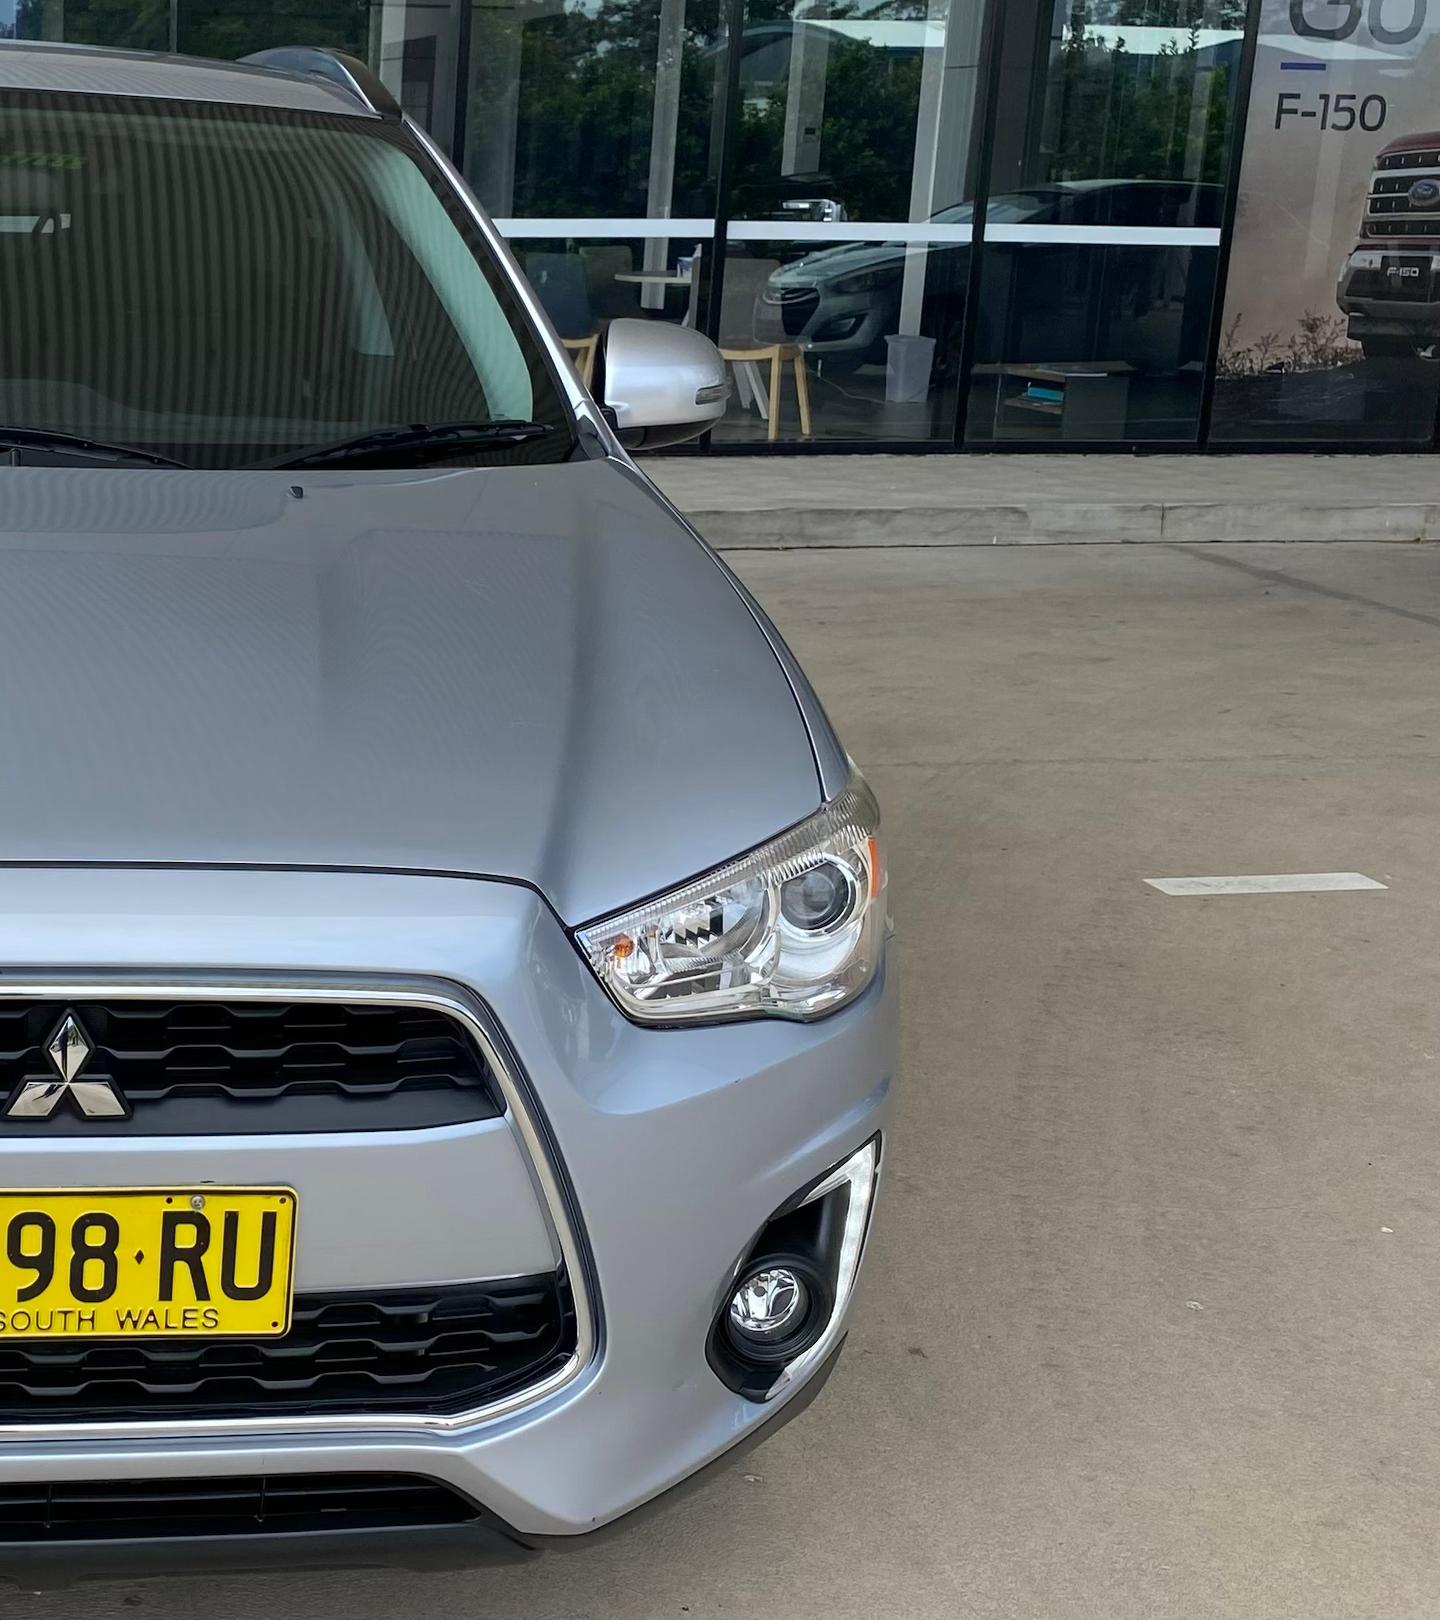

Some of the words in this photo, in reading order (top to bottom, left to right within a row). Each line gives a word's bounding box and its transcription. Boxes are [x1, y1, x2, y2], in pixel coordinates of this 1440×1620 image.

[1275, 93, 1387, 132] F-150
[1386, 266, 1420, 277] F-150
[115, 1307, 219, 1330] WALES
